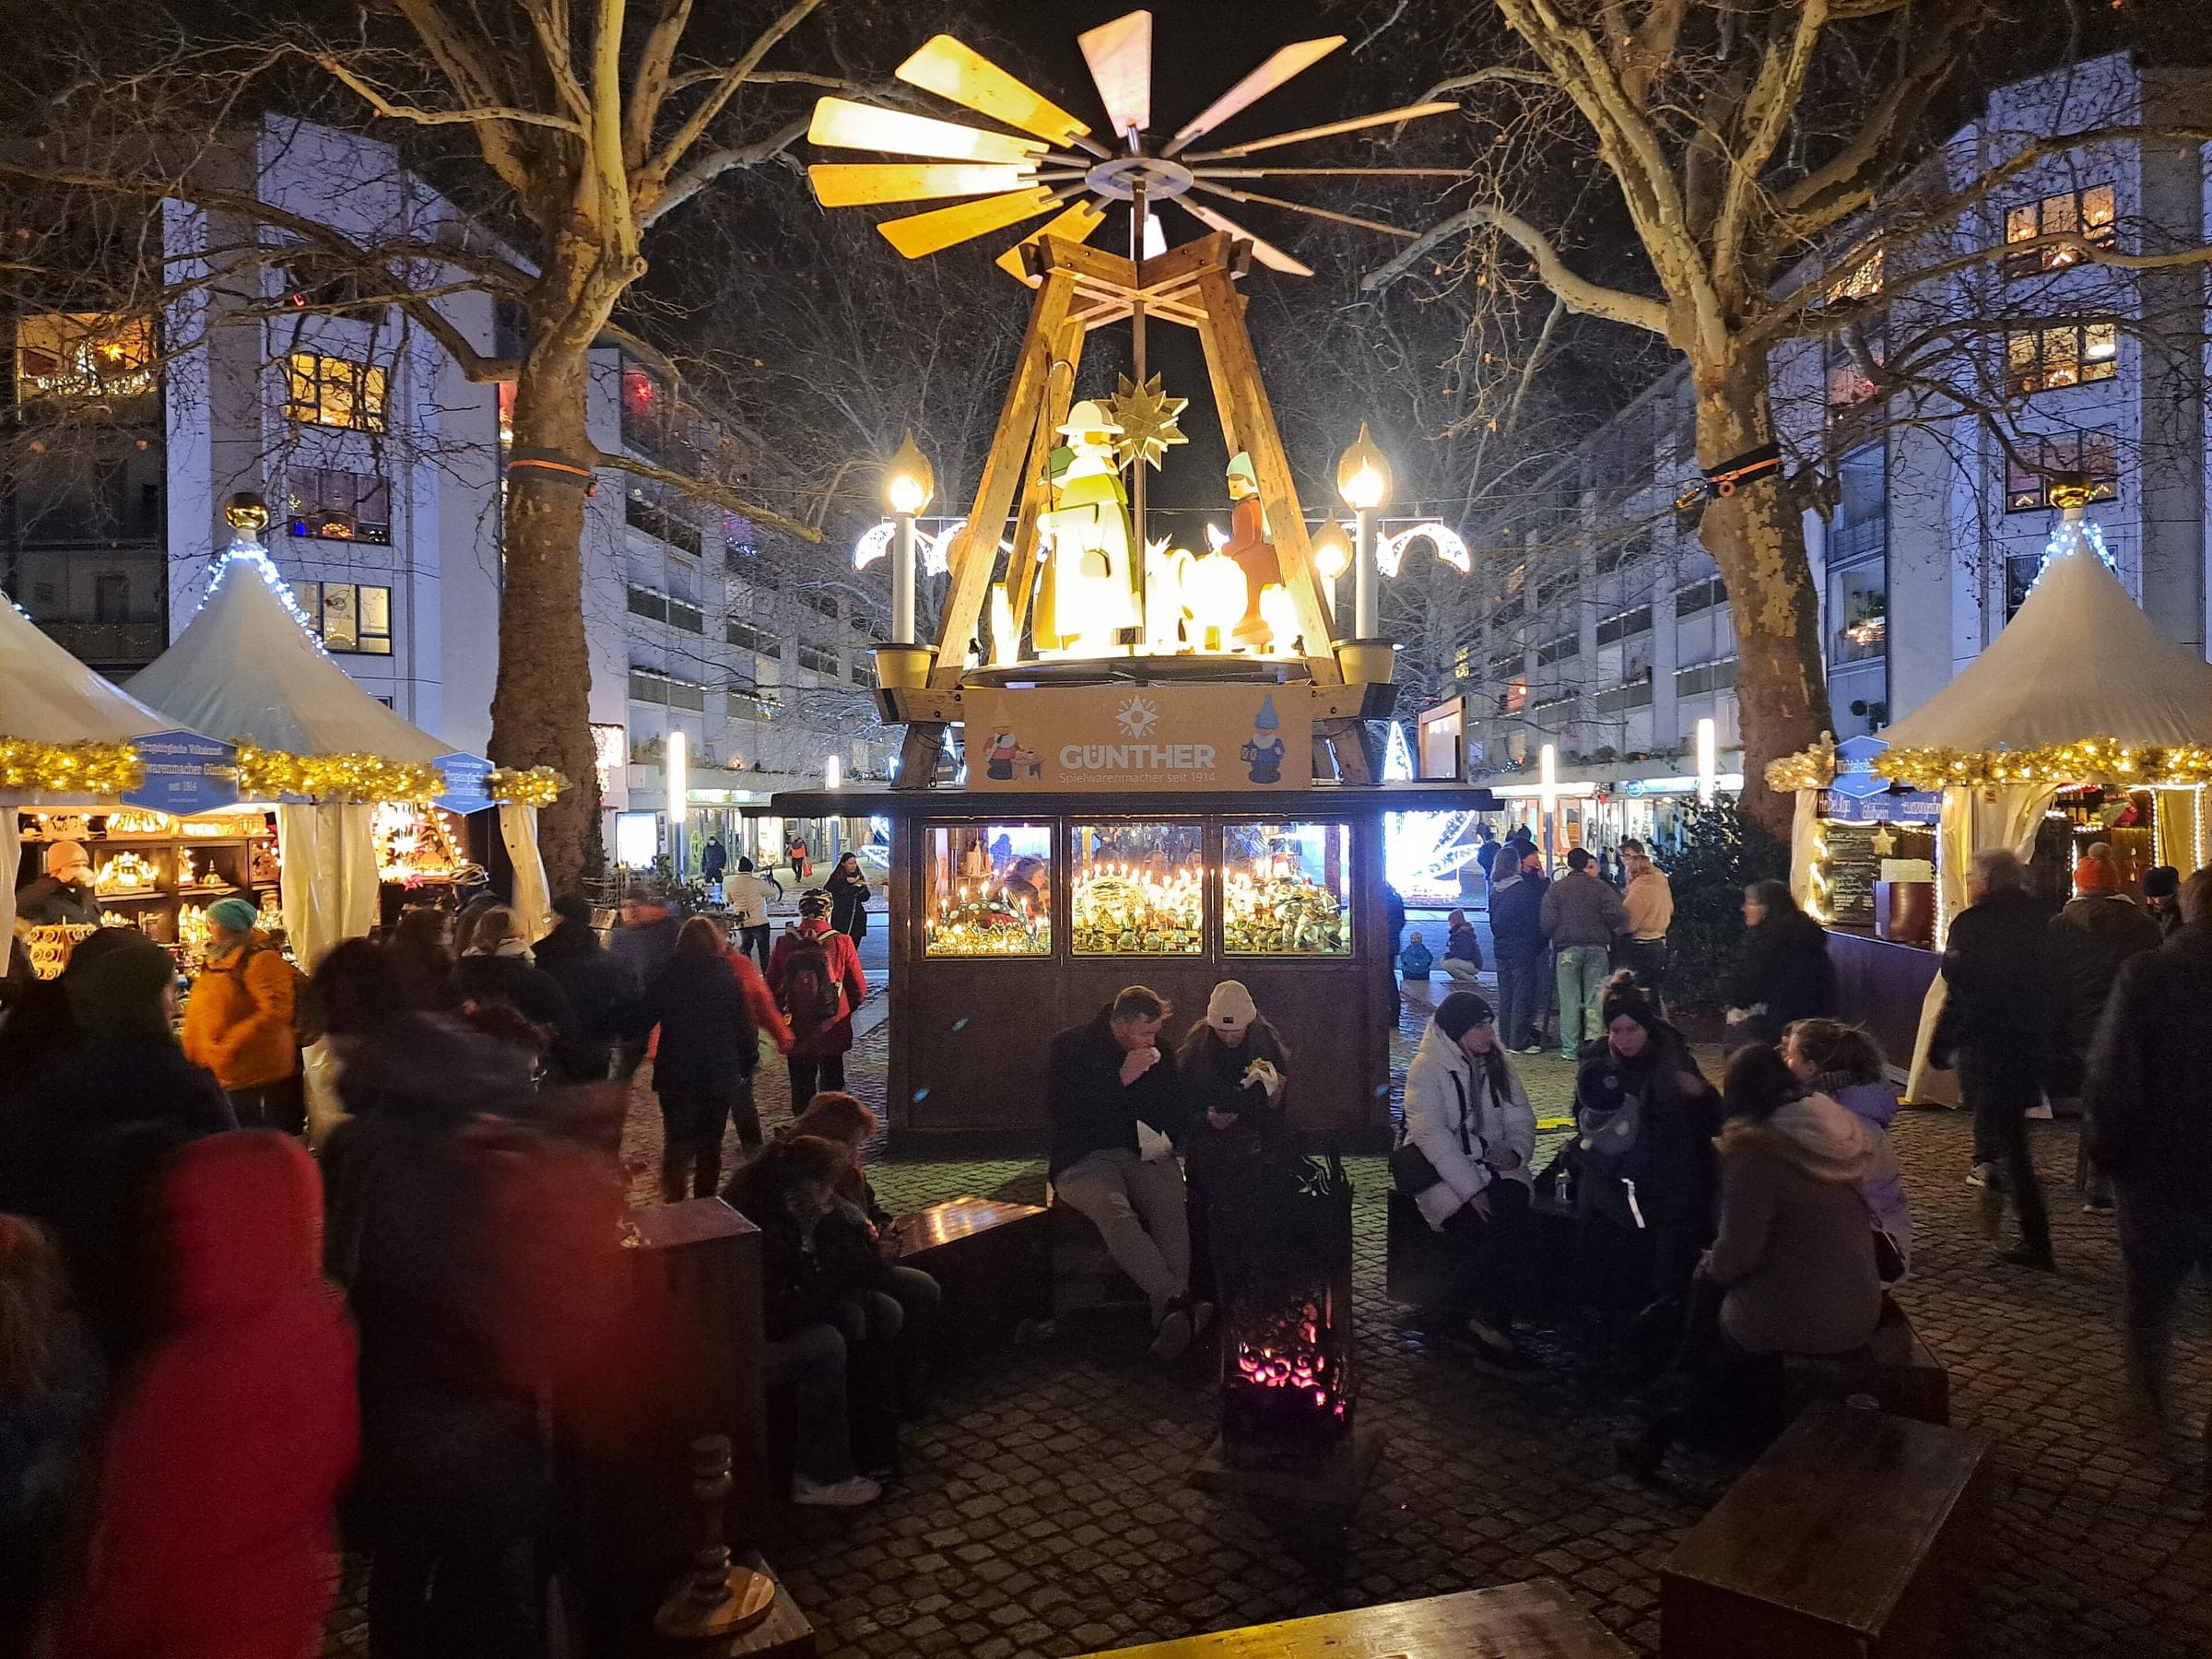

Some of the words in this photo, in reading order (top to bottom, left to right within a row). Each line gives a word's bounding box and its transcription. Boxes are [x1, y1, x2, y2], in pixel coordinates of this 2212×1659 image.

[1059, 744, 1216, 770] GÜNTHER
[145, 762, 202, 775] warenmacher
[1059, 772, 1164, 784] Spielwarenmacher
[1167, 772, 1187, 782] seit
[1191, 771, 1216, 782] 1914
